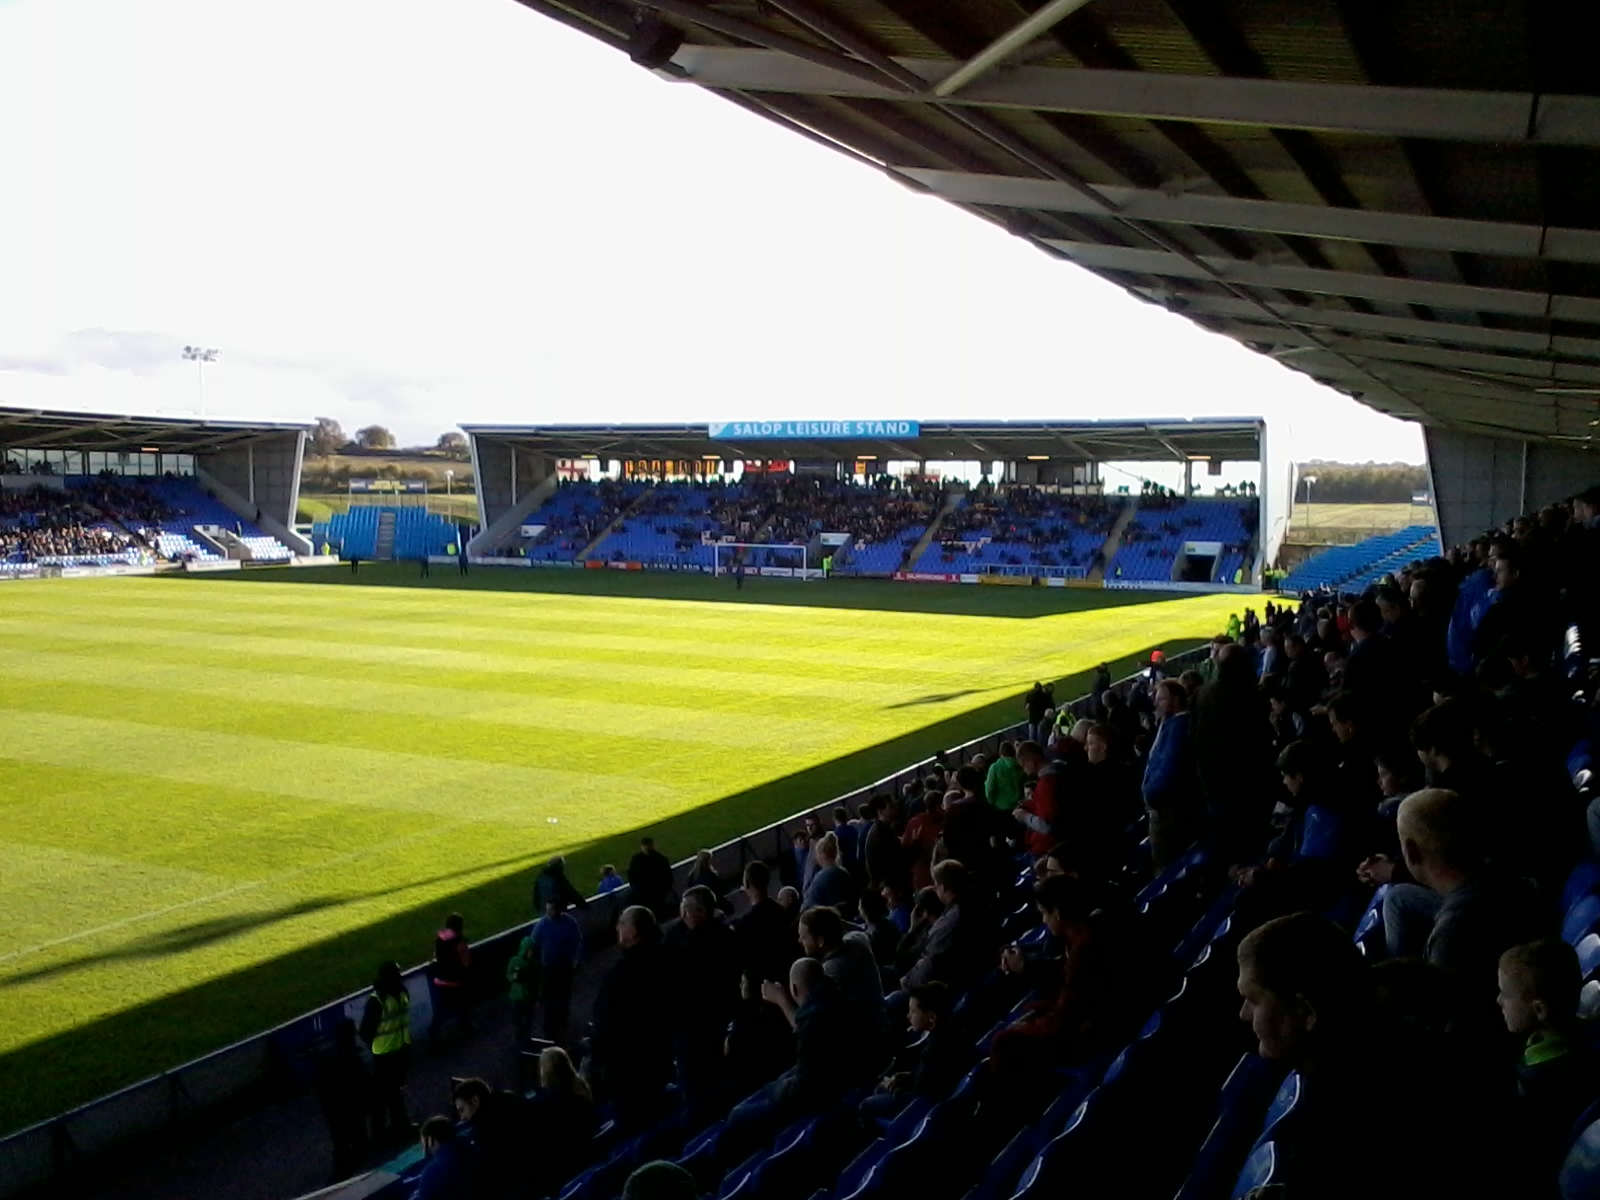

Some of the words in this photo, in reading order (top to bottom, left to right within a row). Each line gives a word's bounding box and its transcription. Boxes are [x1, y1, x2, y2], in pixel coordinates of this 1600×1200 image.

[733, 422, 782, 436] SALOP
[787, 422, 850, 436] LEISURE
[856, 421, 910, 435] STAND
